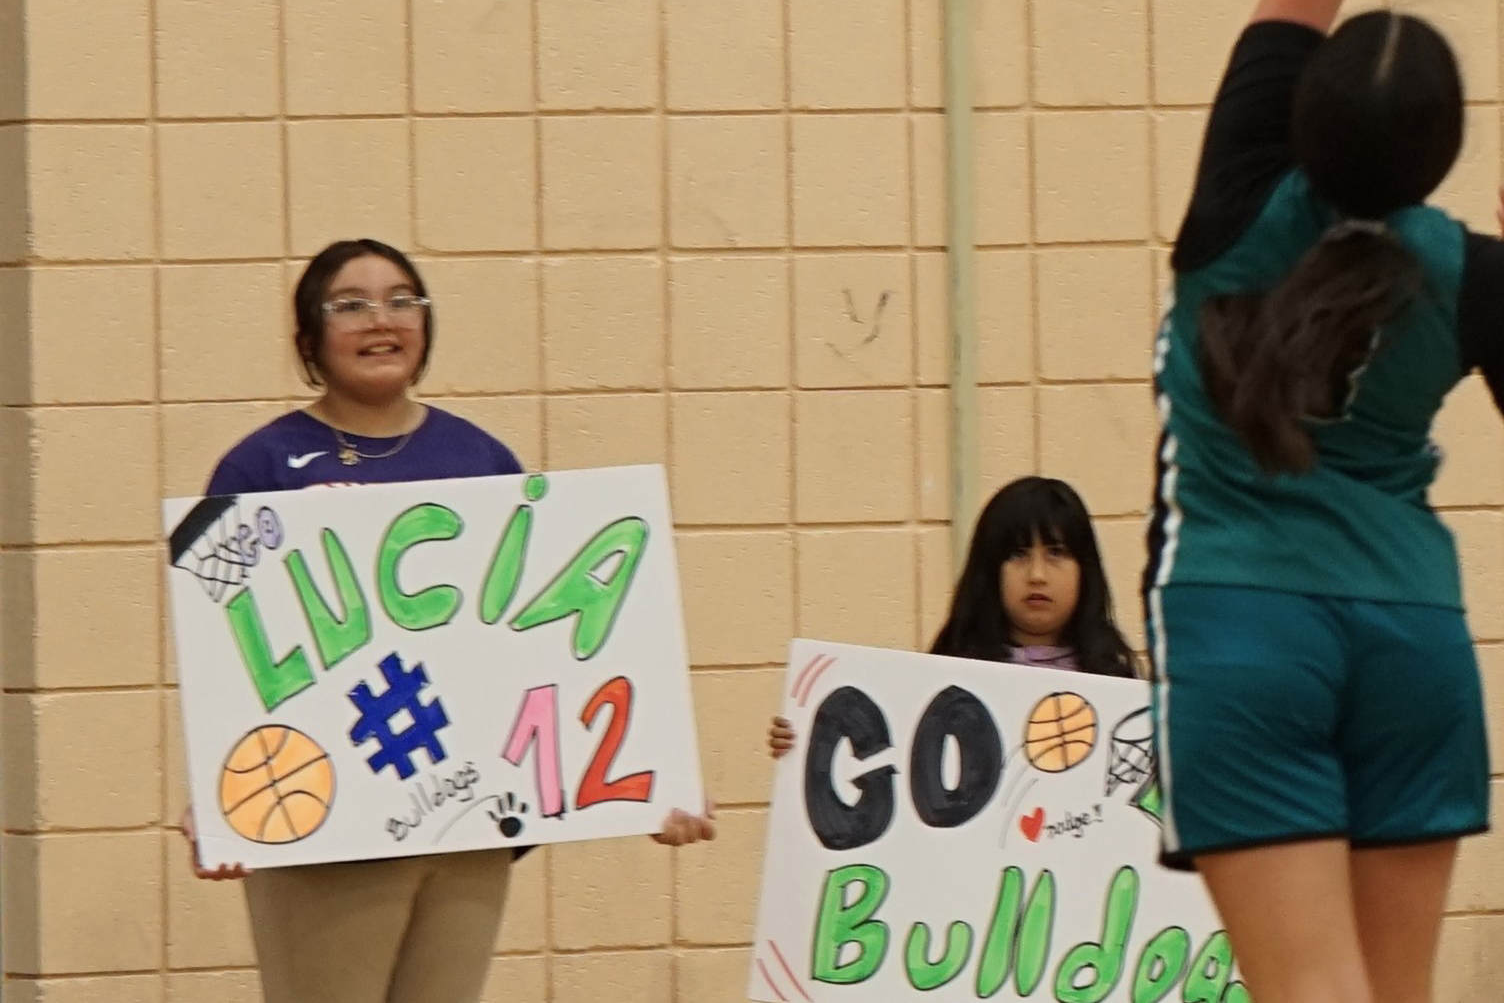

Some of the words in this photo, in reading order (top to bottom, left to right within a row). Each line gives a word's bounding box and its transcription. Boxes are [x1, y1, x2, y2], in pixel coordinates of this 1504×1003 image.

[346, 651, 451, 780] #
[500, 675, 655, 820] 12
[805, 684, 1003, 851] GO
[811, 863, 1256, 1003] Bulldog
